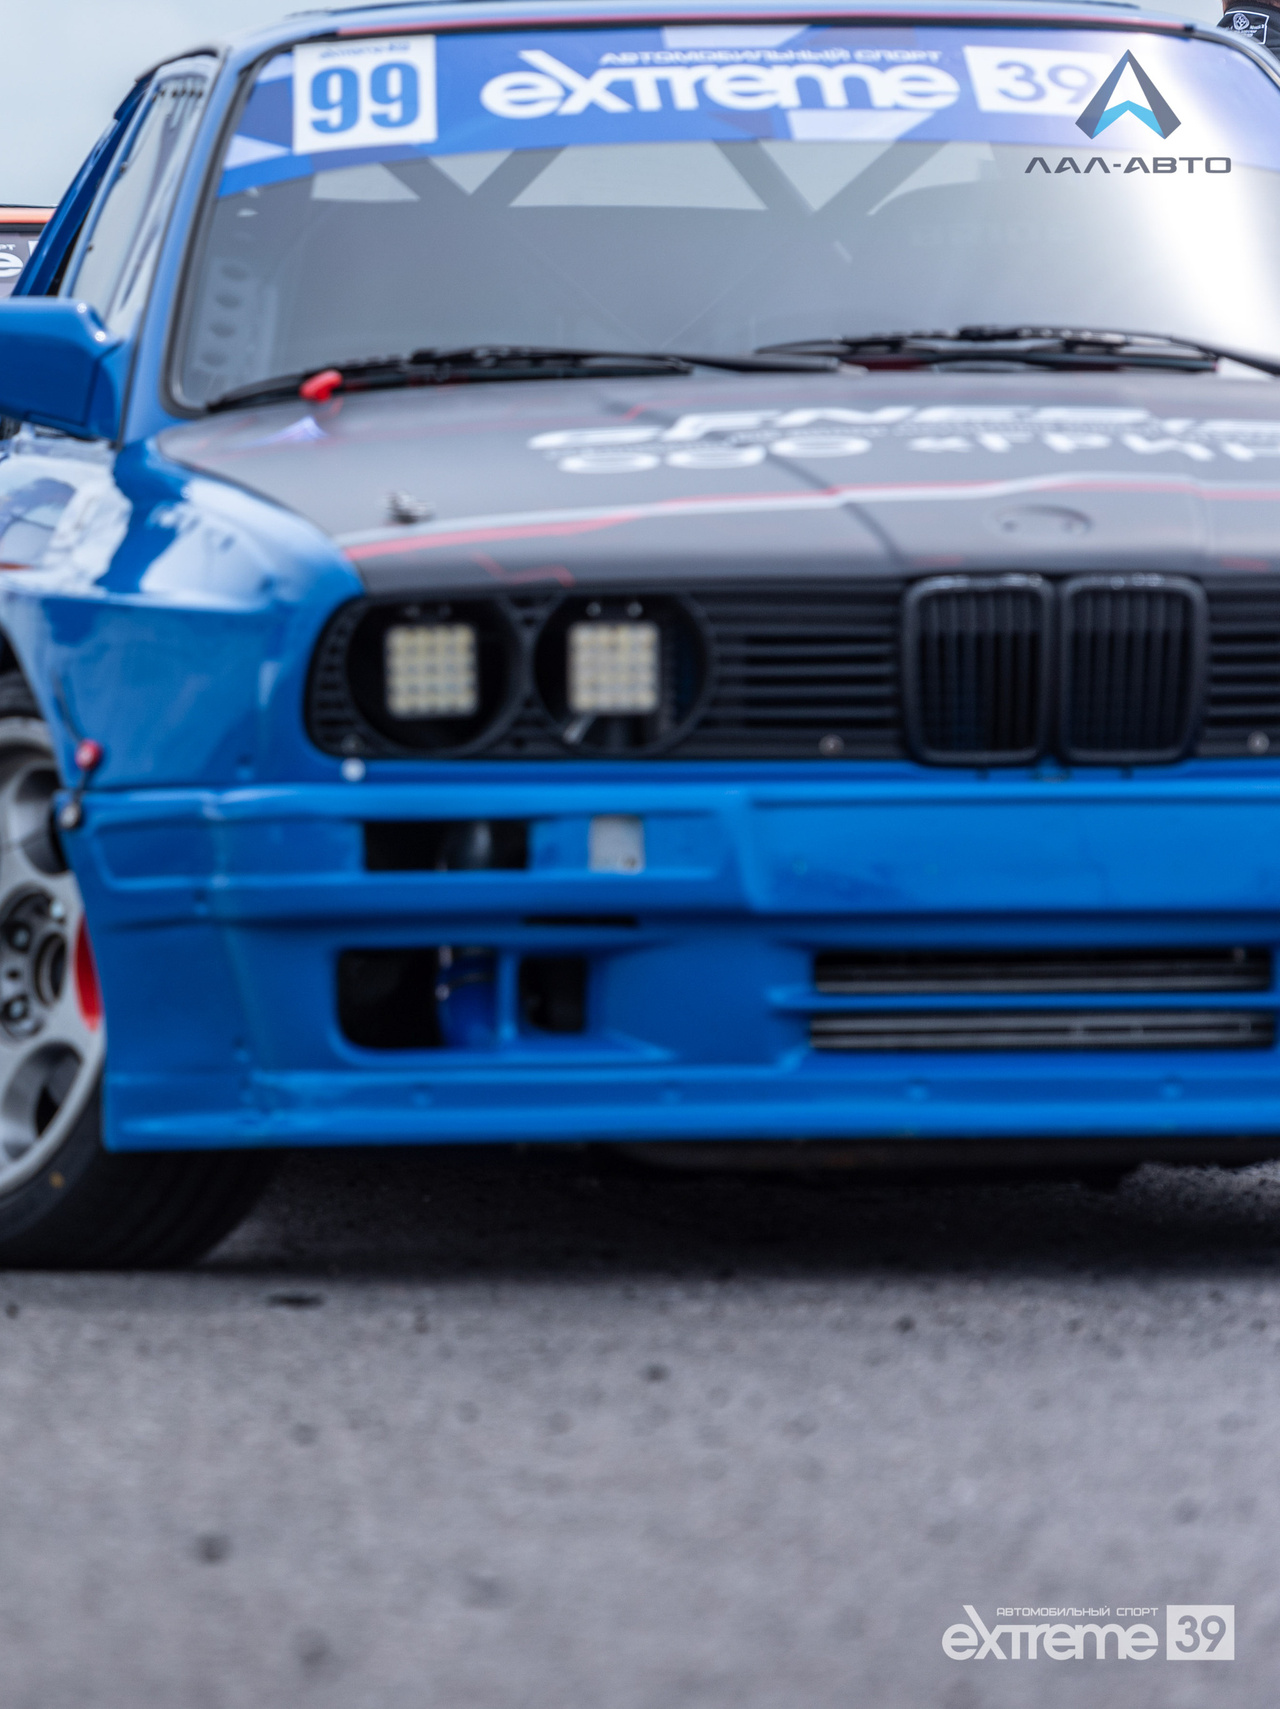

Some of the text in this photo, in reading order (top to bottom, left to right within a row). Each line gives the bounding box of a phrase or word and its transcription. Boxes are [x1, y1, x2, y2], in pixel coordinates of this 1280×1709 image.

[599, 48, 942, 66] АВТОМОБИЛЬНЫЙ СПОРТ
[310, 61, 420, 134] 99
[995, 60, 1097, 104] 39
